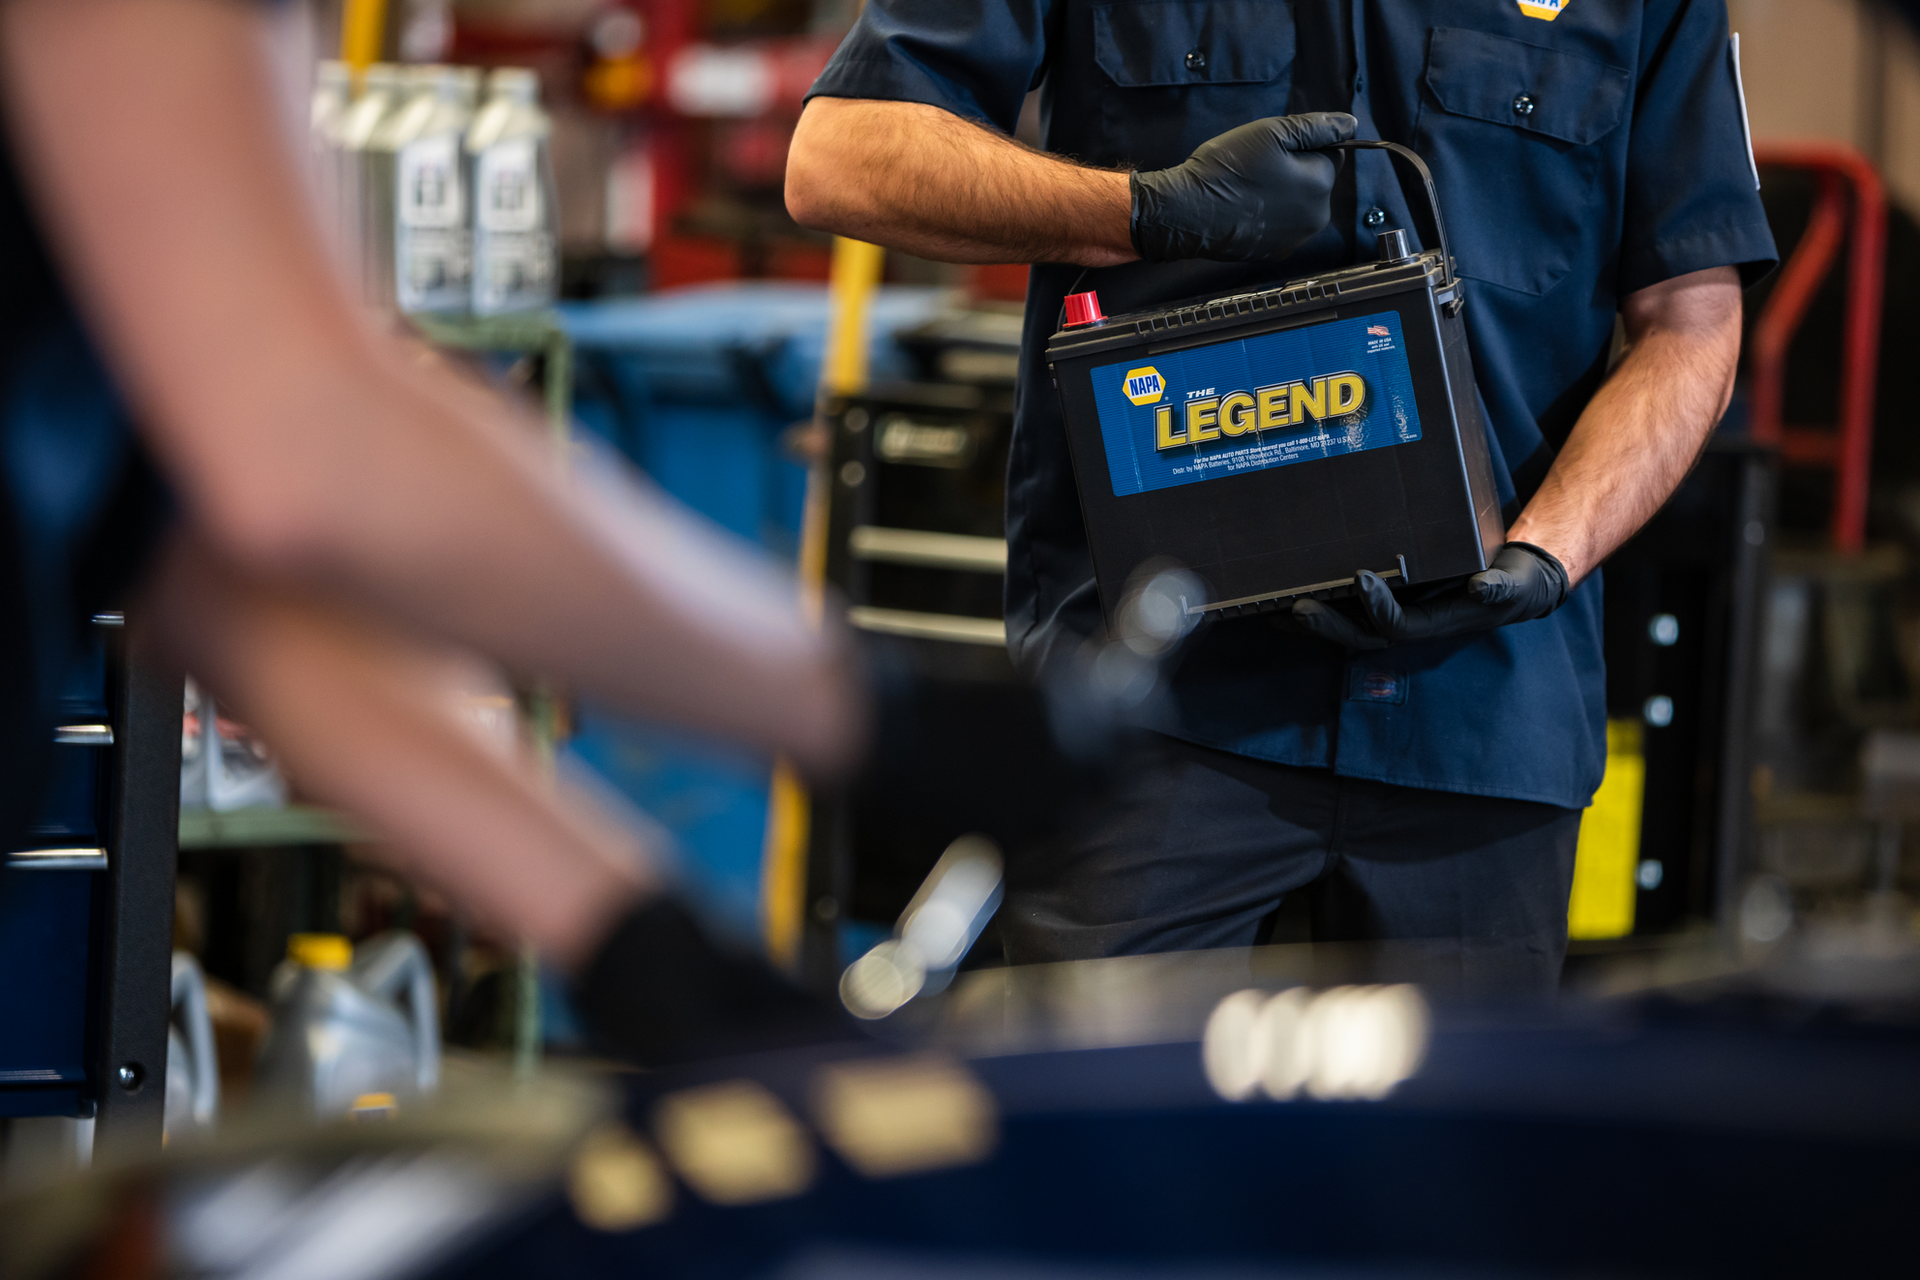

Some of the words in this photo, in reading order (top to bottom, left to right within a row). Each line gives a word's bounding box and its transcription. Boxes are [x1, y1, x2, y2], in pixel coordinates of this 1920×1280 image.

[1129, 374, 1161, 396] NAPA
[1186, 387, 1216, 399] THE
[1155, 370, 1366, 451] LEGEND
[1193, 462, 1208, 471] NAPA
[1231, 455, 1245, 464] 9108
[1310, 441, 1320, 449] MD
[1222, 450, 1235, 459] AUTO
[1234, 448, 1249, 457] PARTS
[1235, 460, 1251, 470] NAPA
[1250, 455, 1280, 467] Distribution
